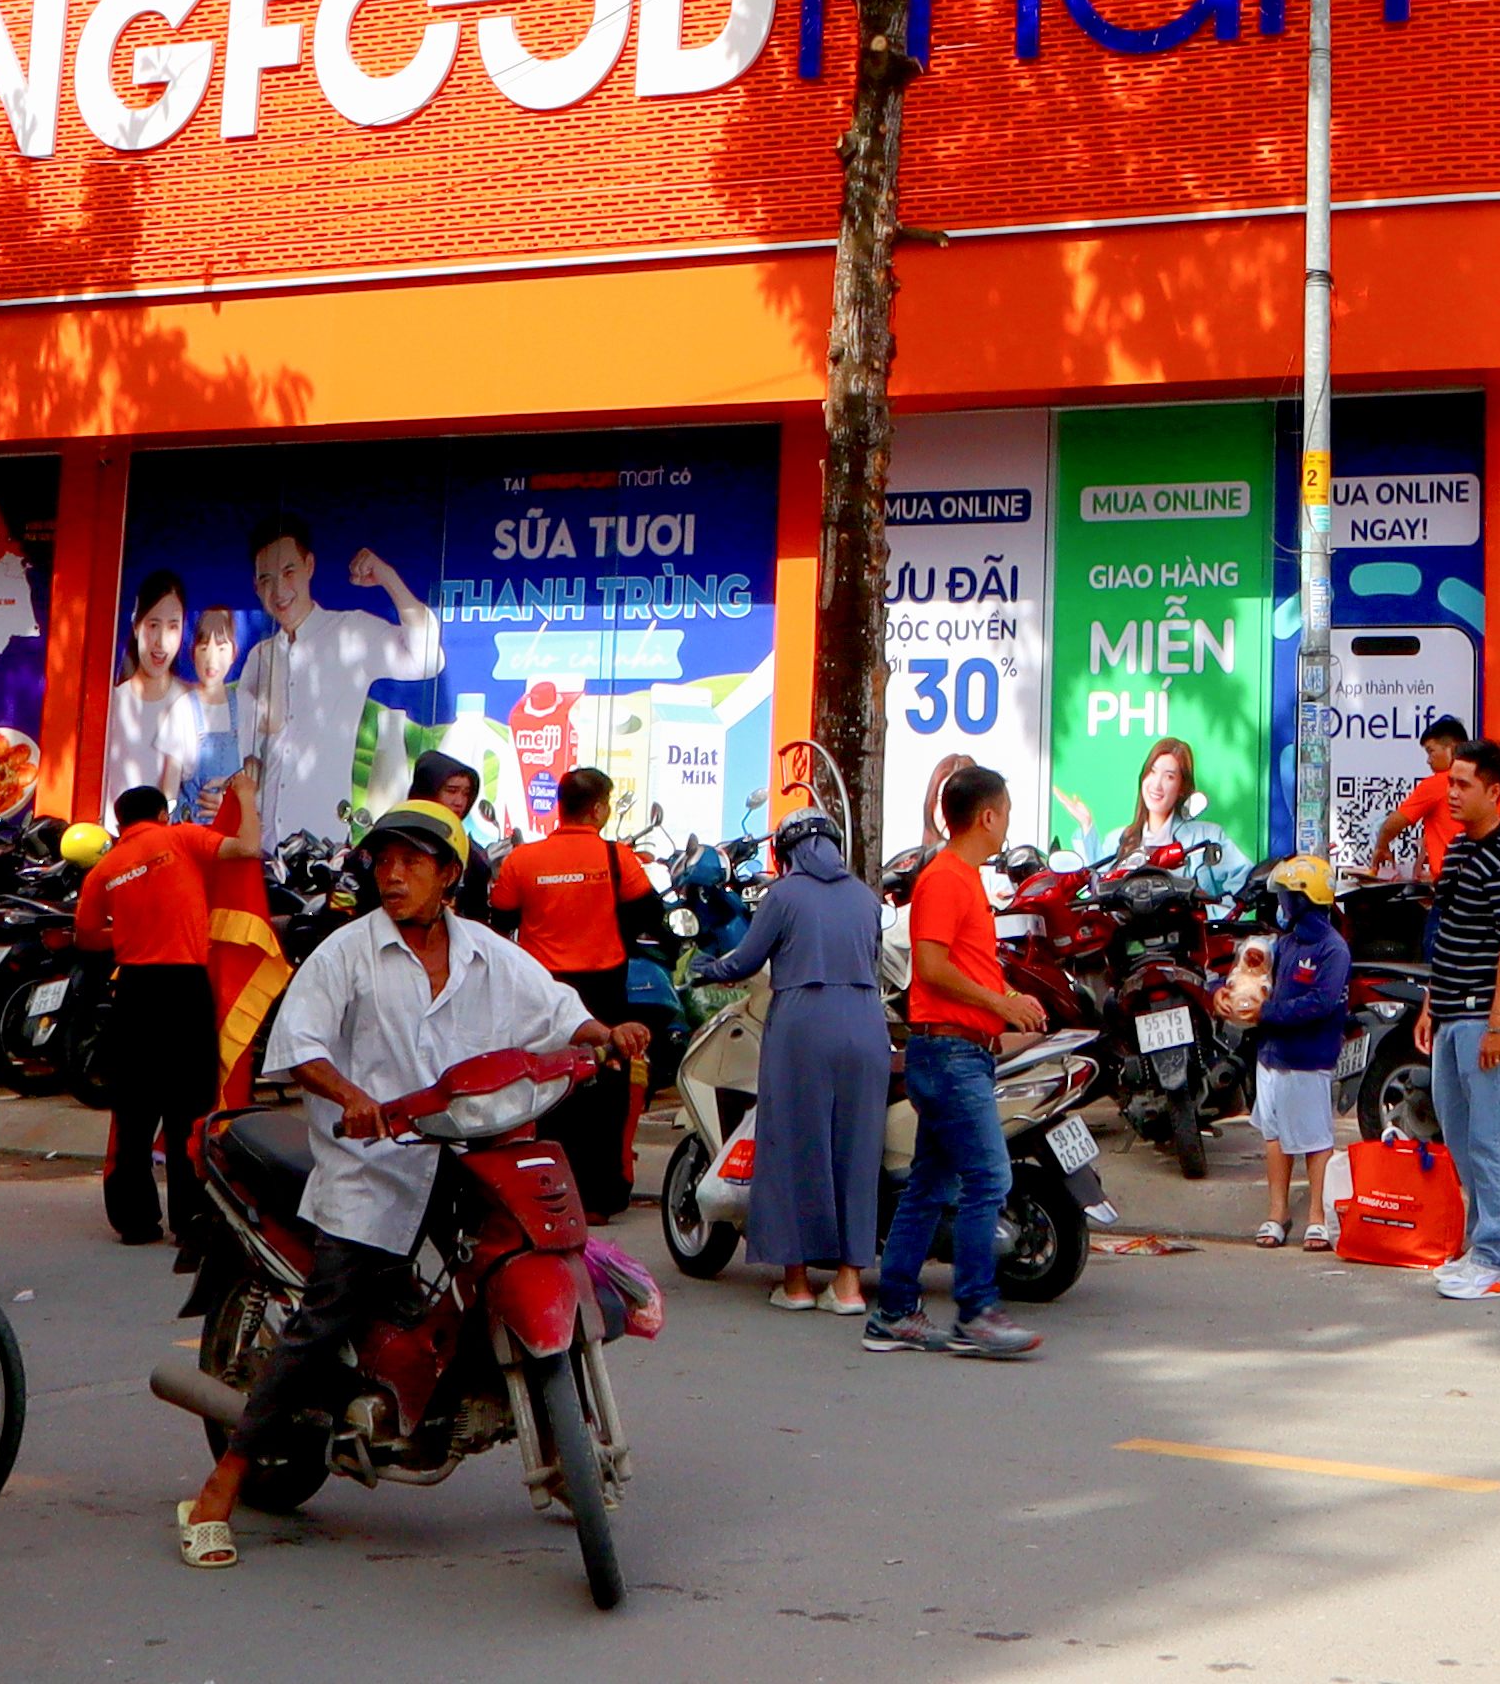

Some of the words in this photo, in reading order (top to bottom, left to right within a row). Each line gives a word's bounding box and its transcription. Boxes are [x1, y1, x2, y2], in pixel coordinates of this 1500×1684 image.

[1307, 469, 1318, 486] 2
[885, 498, 933, 520] MUA
[936, 494, 1023, 518] ONLINE
[1092, 491, 1147, 514] MUA
[1152, 488, 1241, 512] ONLINE
[1333, 483, 1369, 506] UA
[1376, 481, 1470, 504] ONLINE
[492, 507, 577, 560] SỮA
[589, 513, 695, 558] TƯƠI
[1350, 518, 1428, 542] NGAY!
[945, 554, 1018, 603] ĐÃI
[1088, 565, 1154, 589] GIAO
[1160, 555, 1239, 588] HÀNG
[440, 577, 585, 623] THANH
[596, 563, 752, 621] TRÙNG
[936, 610, 1016, 646] QUYỀN
[1088, 594, 1236, 676] MIỄN
[510, 621, 561, 671] cho
[1335, 681, 1362, 696] App
[1366, 680, 1403, 695] thành
[1407, 680, 1434, 695] viên
[1087, 675, 1171, 737] PHÍ
[1327, 705, 1454, 740] OneLif
[516, 725, 562, 754] meiji
[667, 745, 718, 766] Dalat
[682, 770, 717, 784] Milk
[1144, 1010, 1182, 1032] 55-Y5
[1147, 1027, 1185, 1048] 4816
[1052, 1121, 1082, 1149] 59-X3
